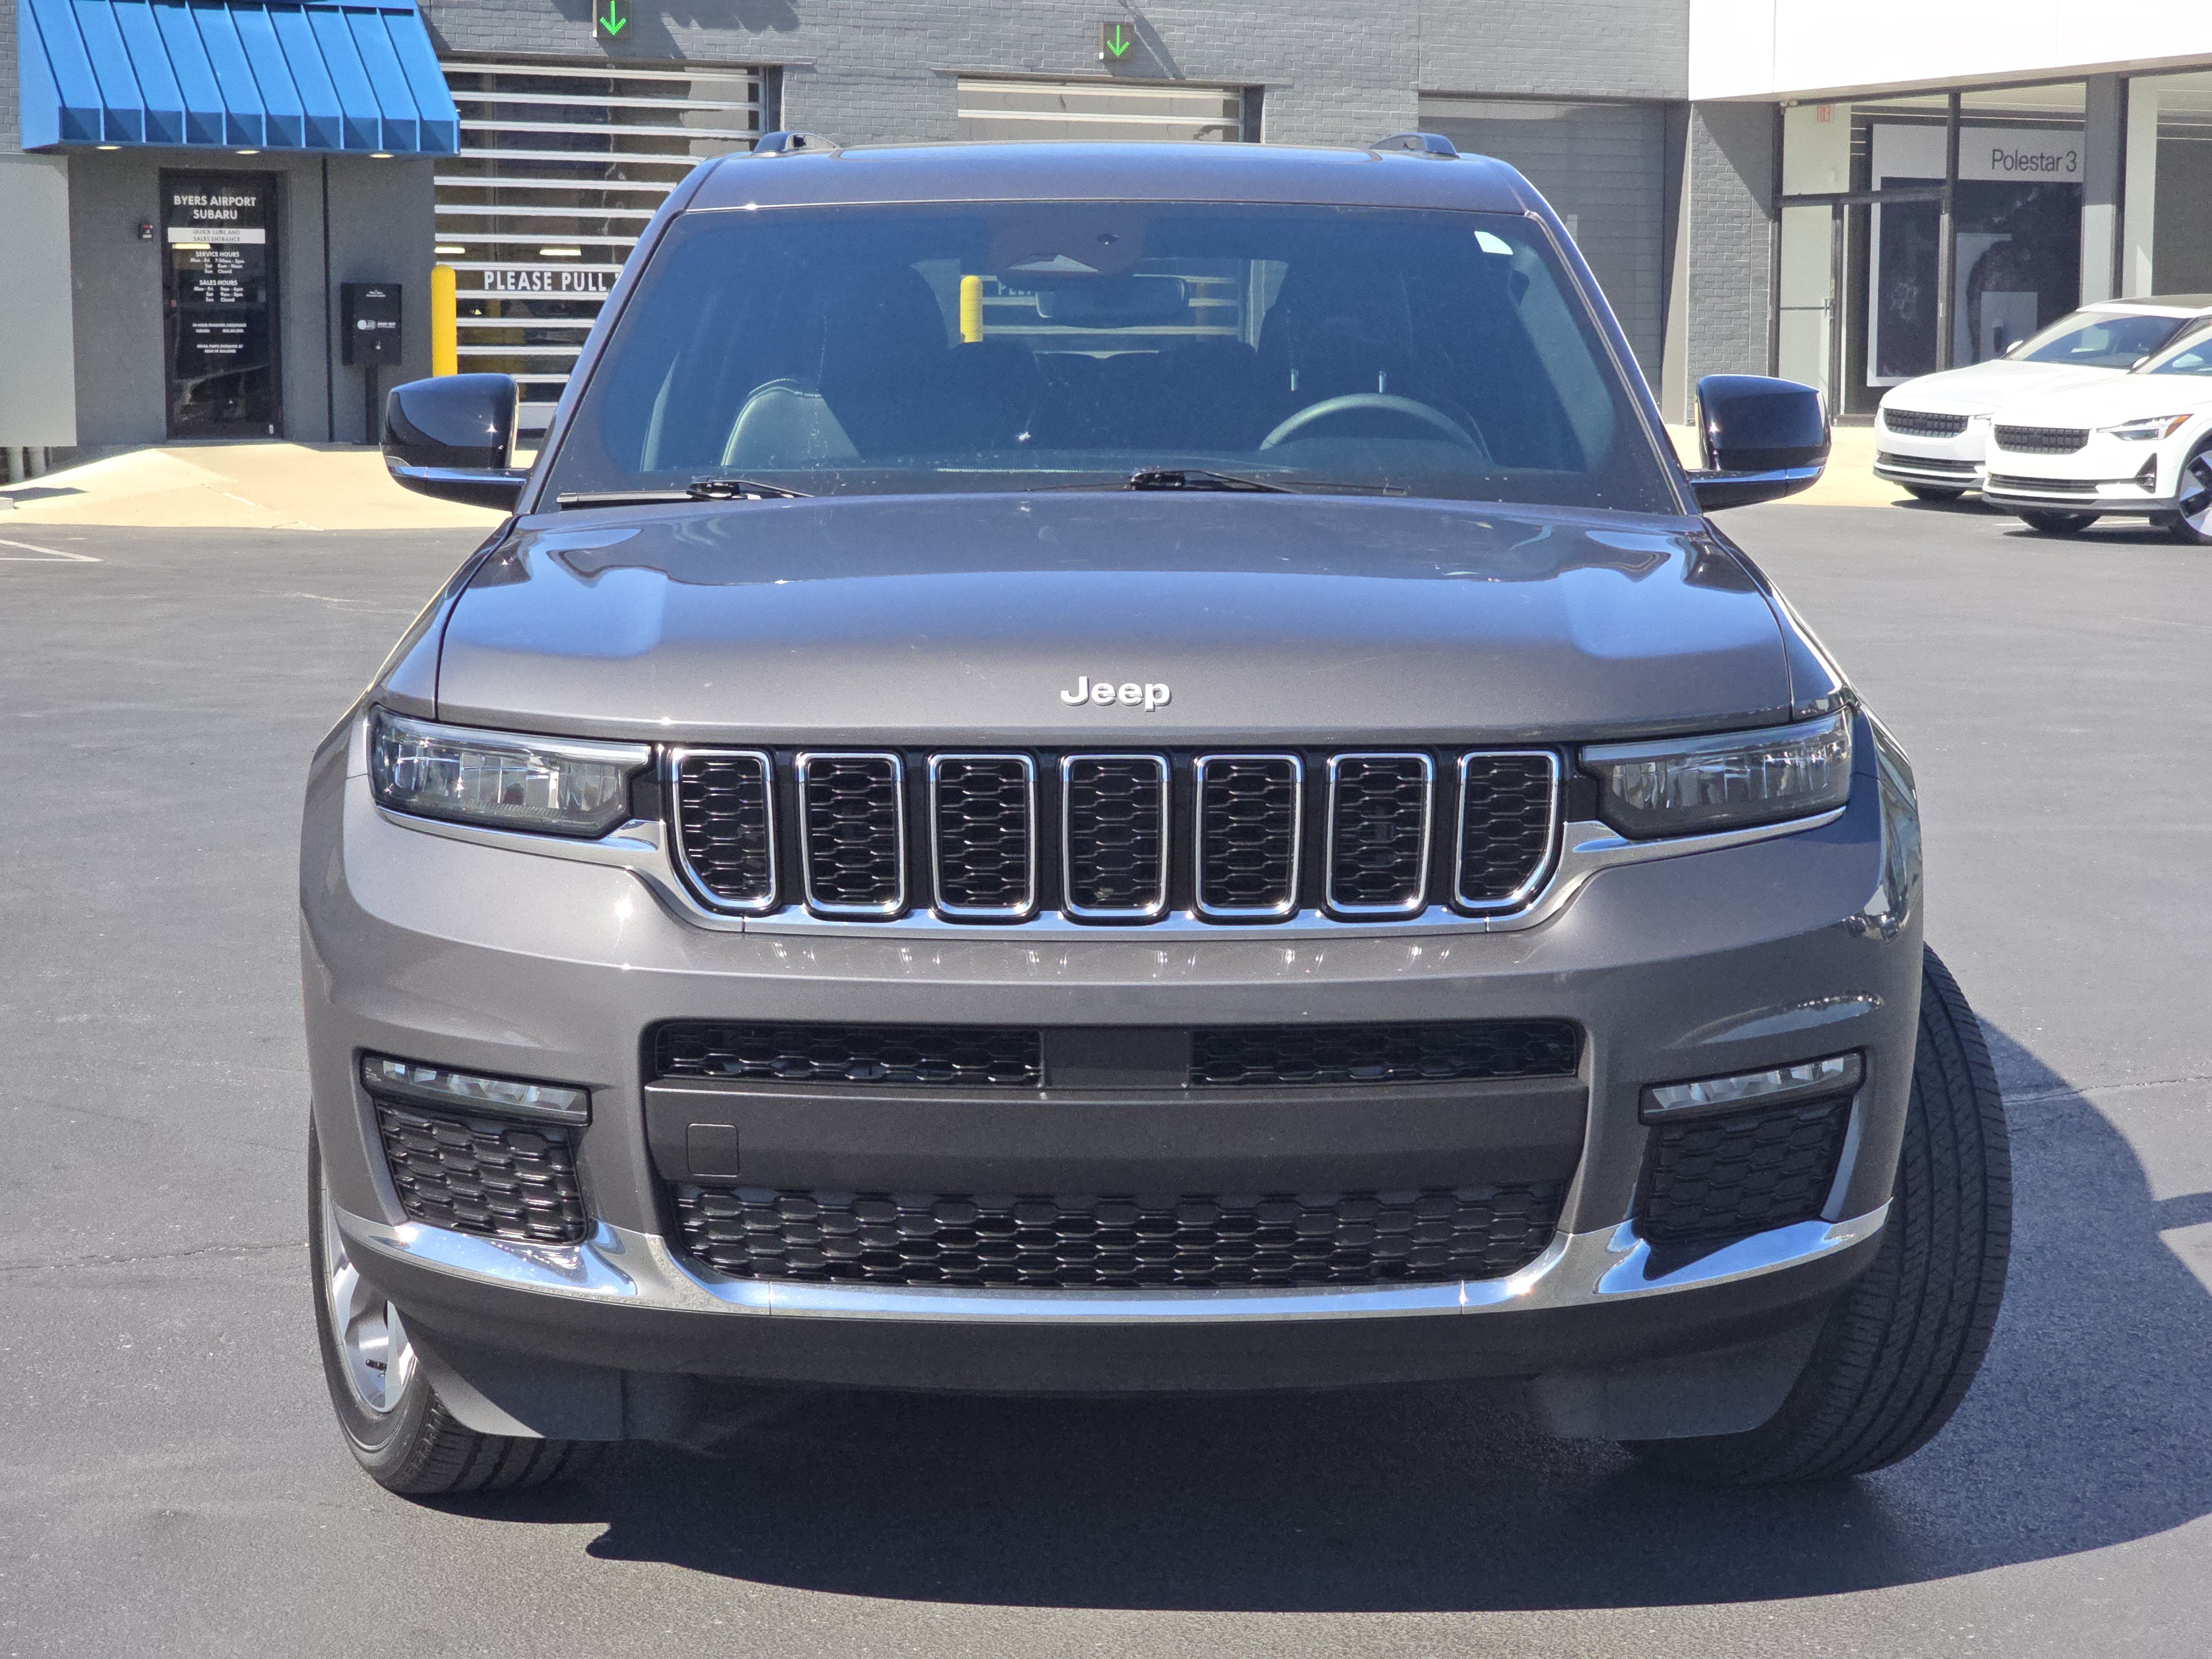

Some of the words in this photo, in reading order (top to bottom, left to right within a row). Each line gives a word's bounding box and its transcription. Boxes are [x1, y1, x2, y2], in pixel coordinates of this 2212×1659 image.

[1992, 149, 2063, 171] Polestar
[2065, 150, 2077, 172] 3
[174, 195, 207, 206] BYERS
[210, 196, 257, 206] AIRPORT
[193, 210, 238, 220] SUBARU
[484, 271, 552, 290] PLEASE
[561, 272, 607, 291] PULL
[1061, 676, 1172, 712] Jeep
